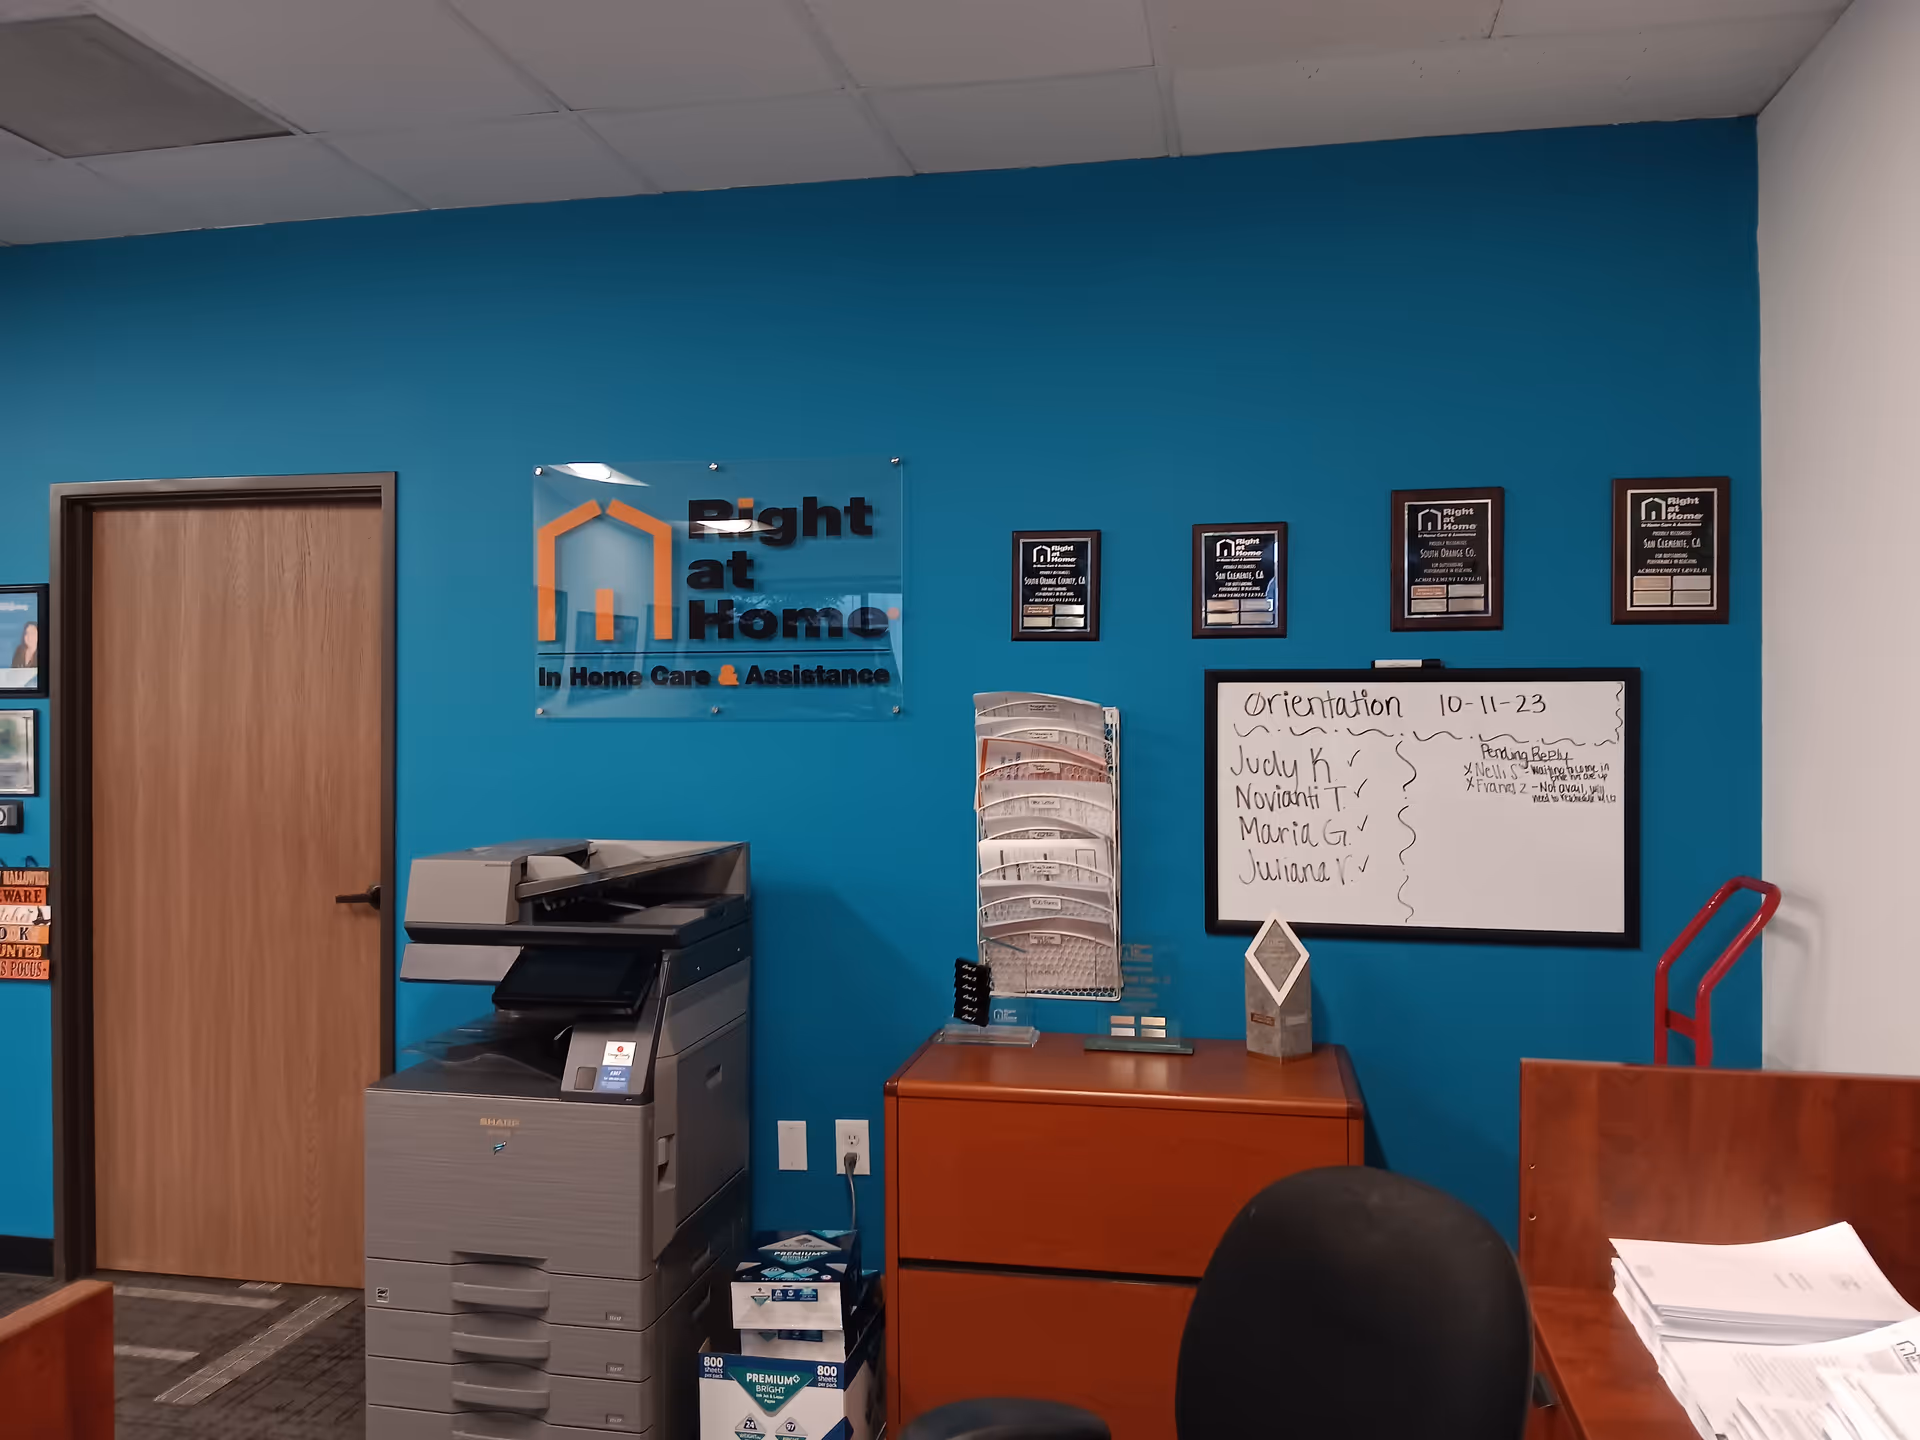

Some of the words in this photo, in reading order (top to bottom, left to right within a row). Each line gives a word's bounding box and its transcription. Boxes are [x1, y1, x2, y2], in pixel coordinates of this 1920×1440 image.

[1443, 508, 1474, 516] Right
[1667, 497, 1699, 506] Right
[688, 496, 873, 547] Right
[1236, 538, 1260, 546] Right
[686, 550, 755, 589] at
[688, 599, 890, 640] Home
[538, 666, 562, 687] In
[569, 666, 643, 687] Home
[651, 665, 711, 687] Care
[718, 664, 740, 686] &
[745, 664, 891, 687] Assistance
[1244, 688, 1404, 719] Orientation
[1439, 693, 1547, 715] 10-11-23
[1481, 743, 1529, 769] Pending
[1230, 744, 1299, 793] Judy
[1235, 782, 1320, 812] Novianti
[1238, 815, 1319, 847] Maria
[1238, 849, 1331, 885] Juliana
[703, 1356, 724, 1367] 800
[817, 1365, 838, 1376] 800
[746, 1372, 793, 1386] PREMIUM
[755, 1385, 786, 1394] BRIGHT
[745, 1421, 755, 1429] 24
[786, 1423, 795, 1431] 97
